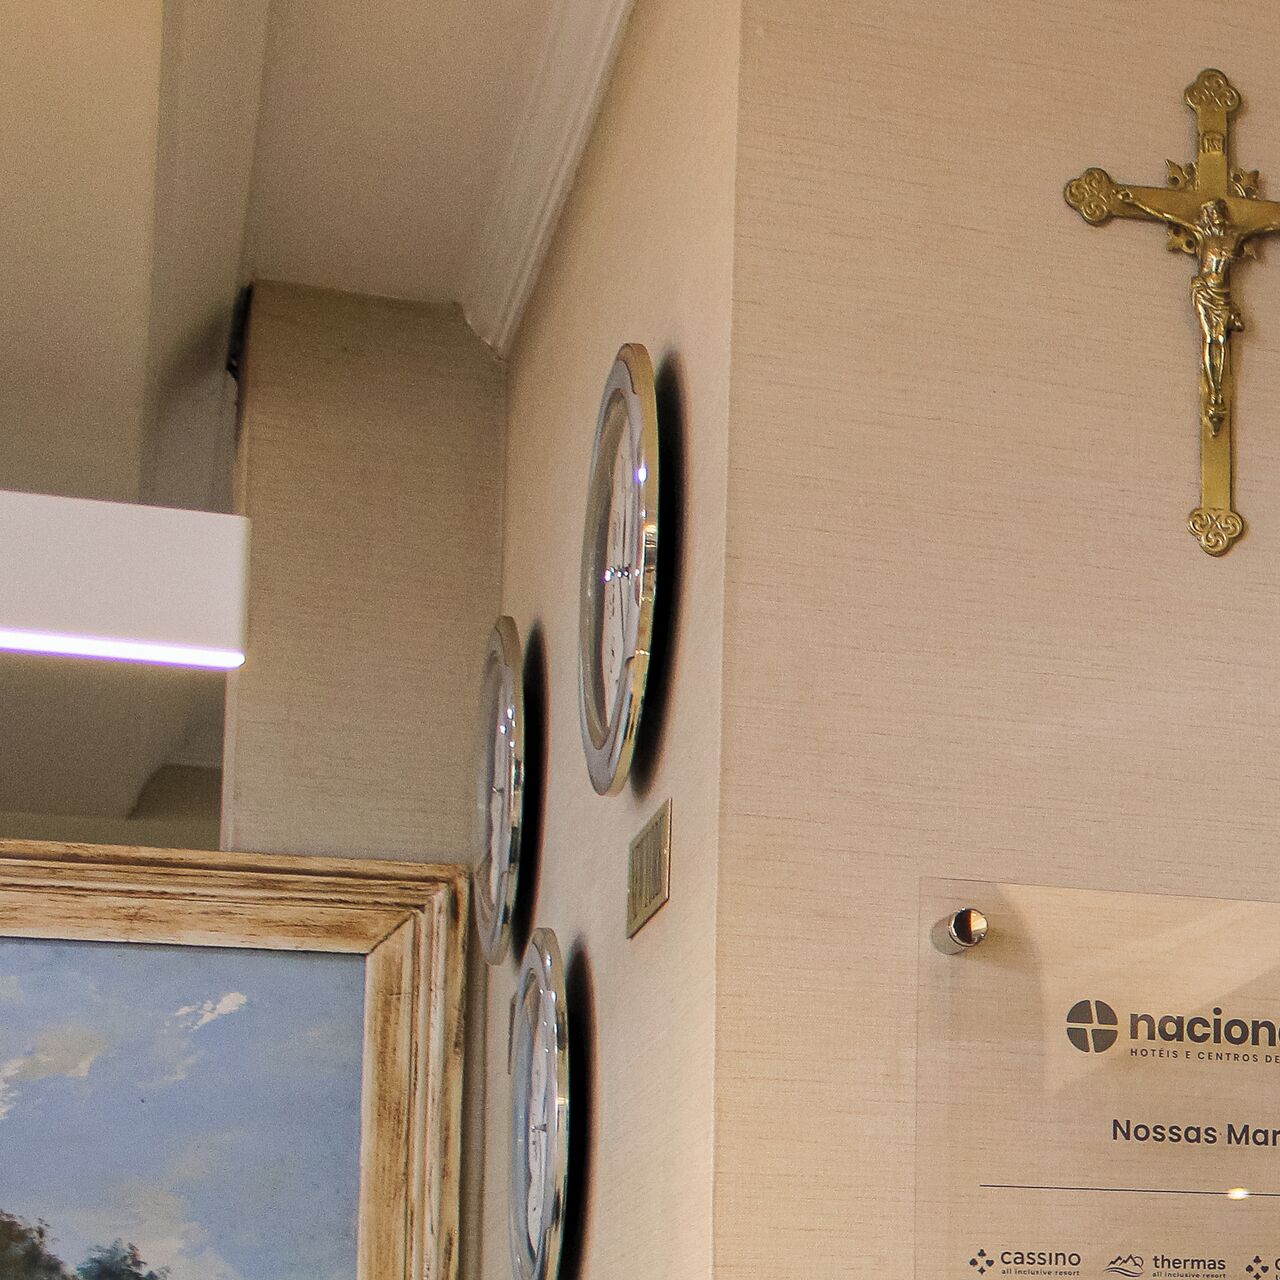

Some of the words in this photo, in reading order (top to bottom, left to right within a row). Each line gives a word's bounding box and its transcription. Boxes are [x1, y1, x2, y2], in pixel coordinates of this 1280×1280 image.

[1130, 1047, 1179, 1059] HOTÉIS
[1185, 1050, 1192, 1059] E
[1197, 1051, 1259, 1063] CENTROS
[1265, 1054, 1280, 1064] DE
[1112, 1119, 1218, 1144] Nossas
[1000, 1250, 1081, 1266] cassino
[1152, 1254, 1227, 1270] thermas
